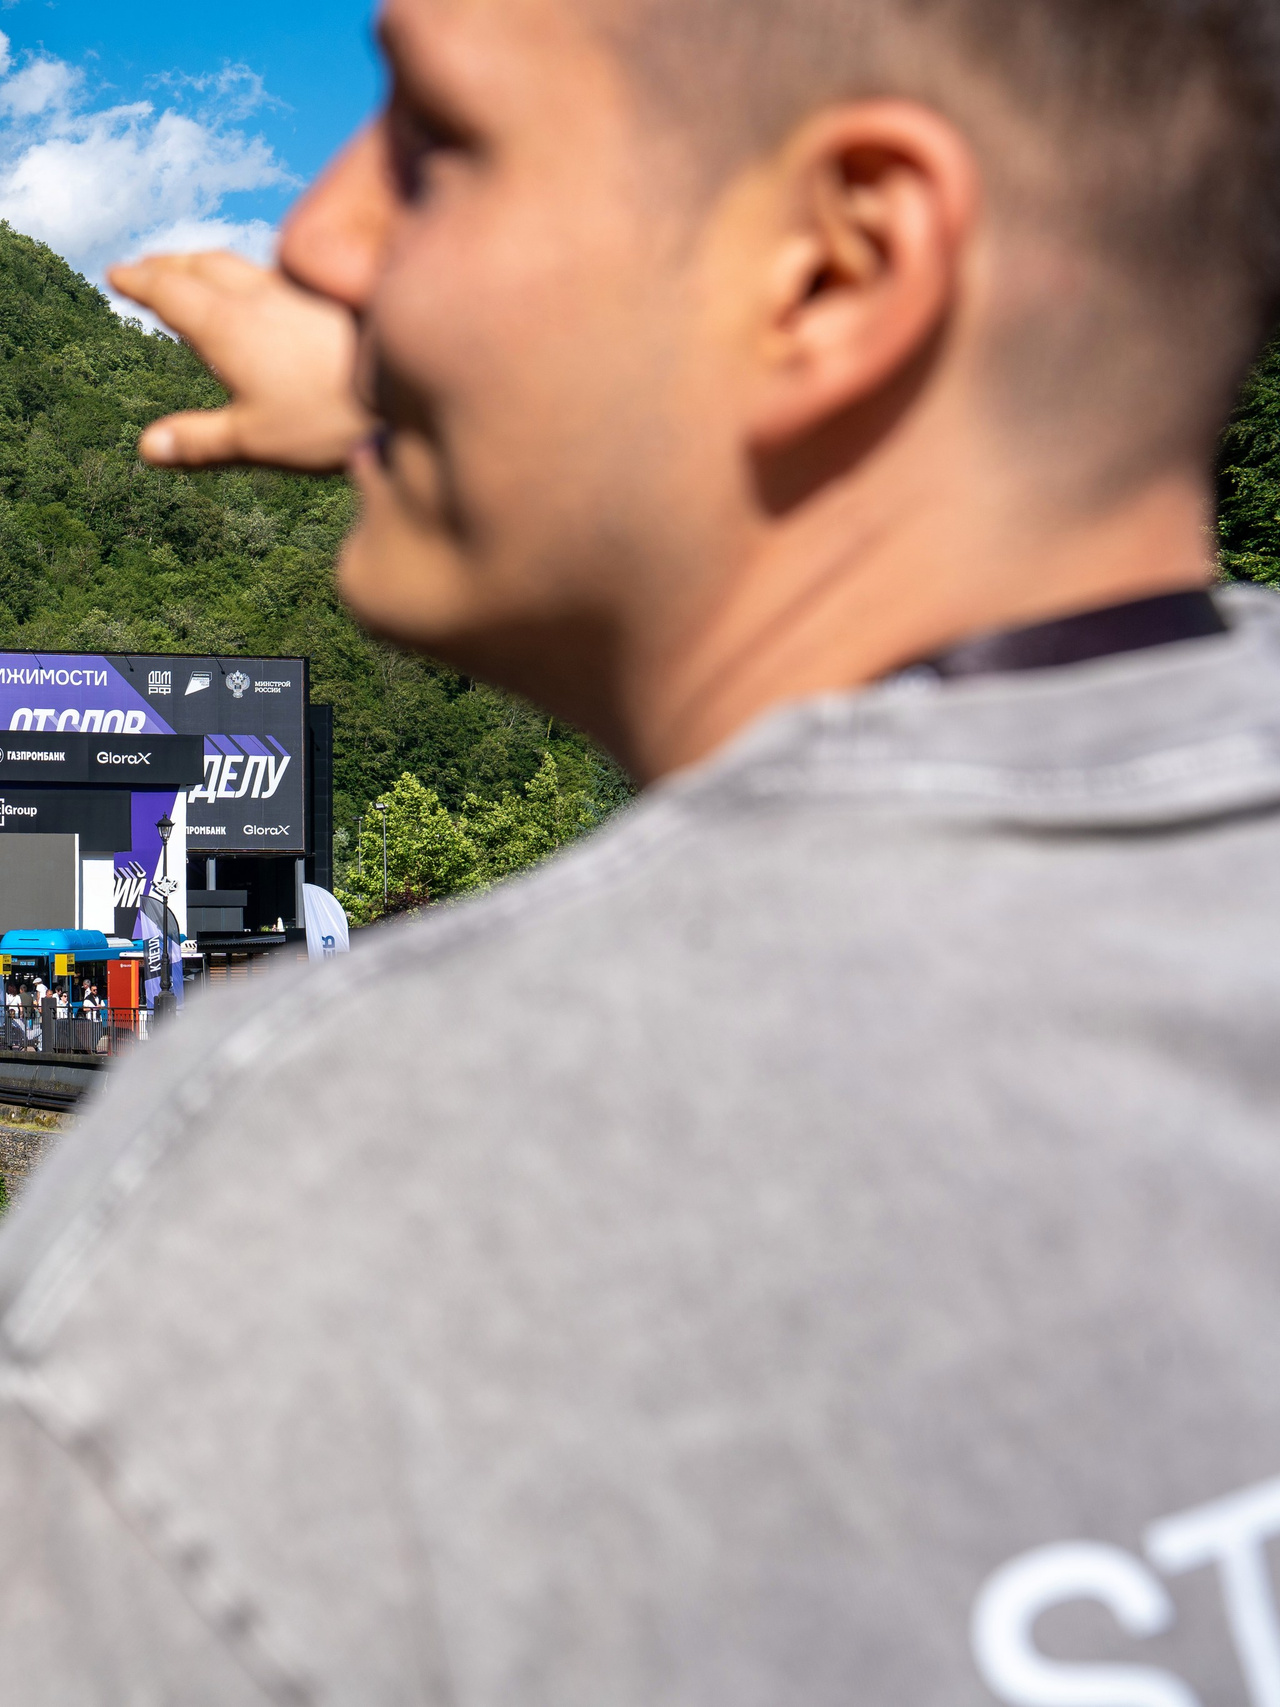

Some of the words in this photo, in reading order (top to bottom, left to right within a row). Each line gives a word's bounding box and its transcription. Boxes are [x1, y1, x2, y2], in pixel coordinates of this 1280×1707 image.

[255, 680, 291, 688] МИНСТРОЙ
[7, 751, 66, 762] ГАЗПРОМБАНК
[96, 751, 152, 765] GloraX
[187, 755, 292, 803] ДЕЛУ
[243, 824, 290, 835] GloraX
[114, 871, 147, 907] ИЙ
